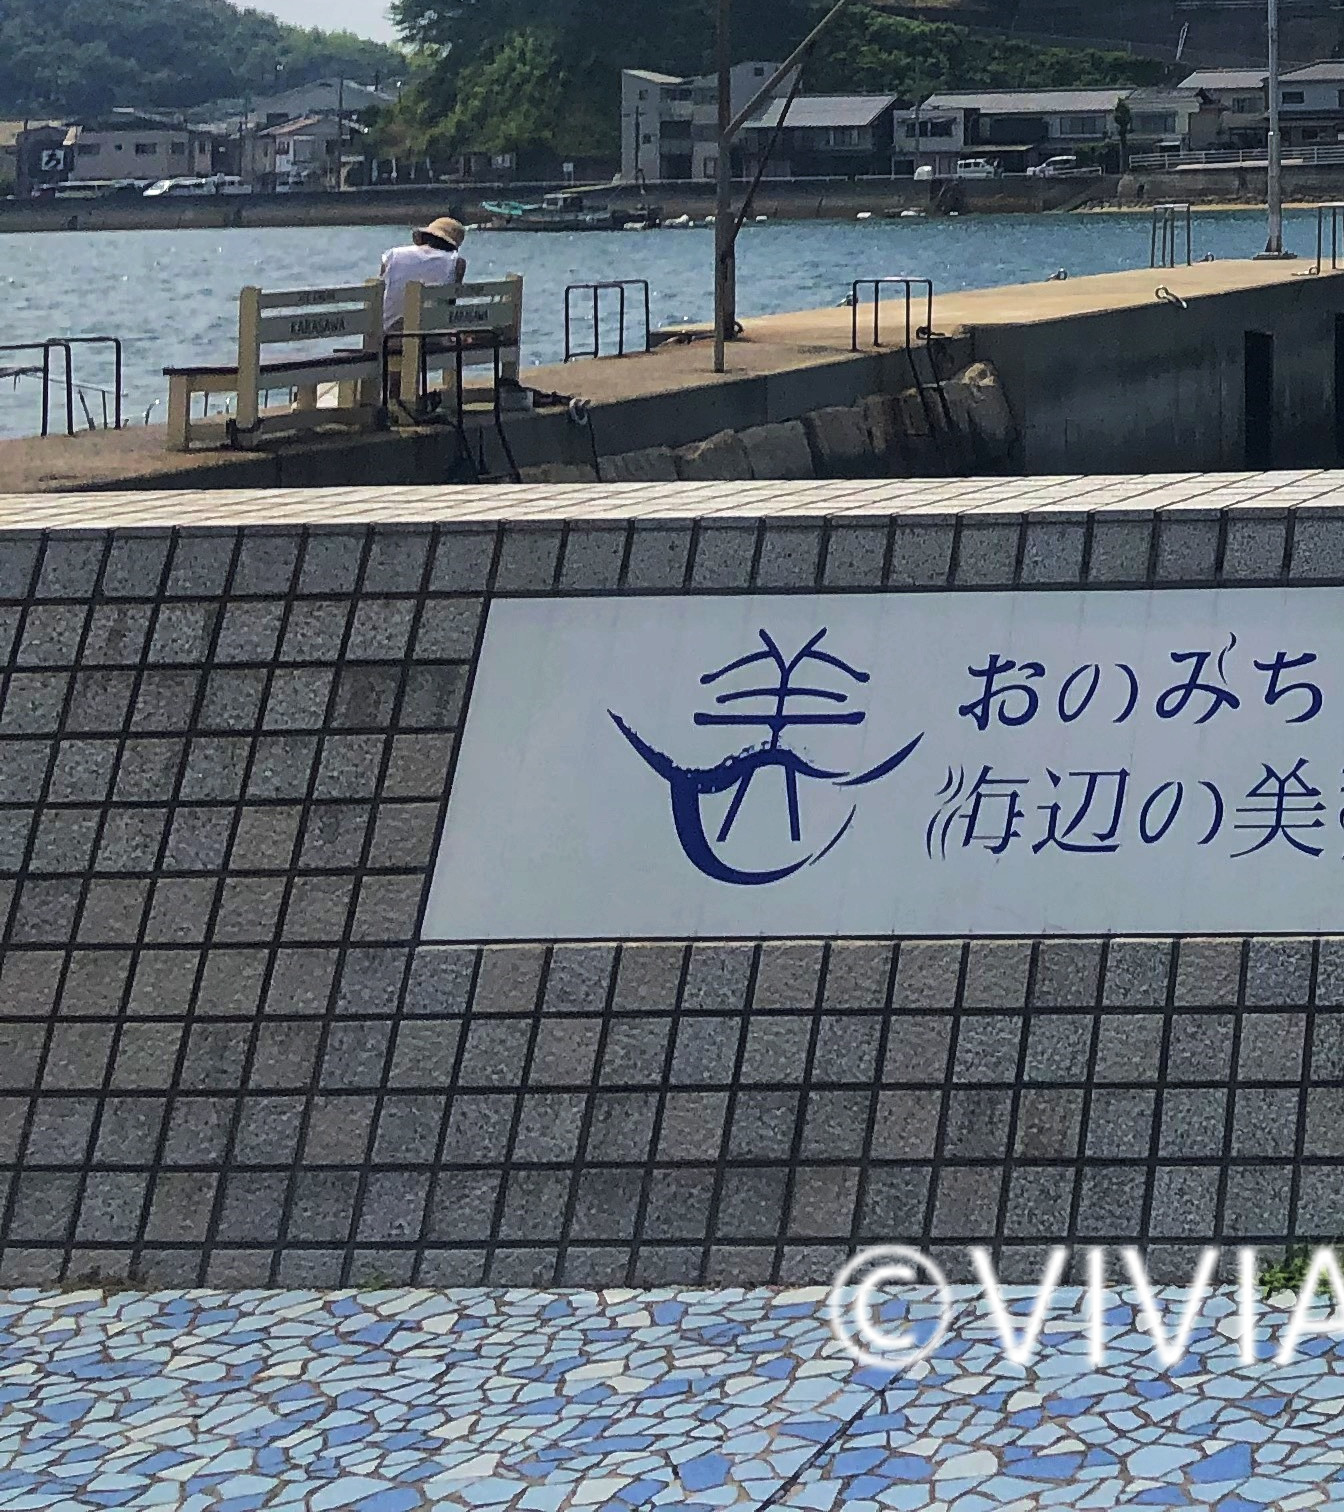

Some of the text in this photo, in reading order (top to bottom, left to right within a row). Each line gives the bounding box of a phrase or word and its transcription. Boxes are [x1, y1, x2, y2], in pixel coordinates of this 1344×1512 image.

[290, 317, 346, 334] KARASAWA
[959, 632, 1324, 731] おのみち
